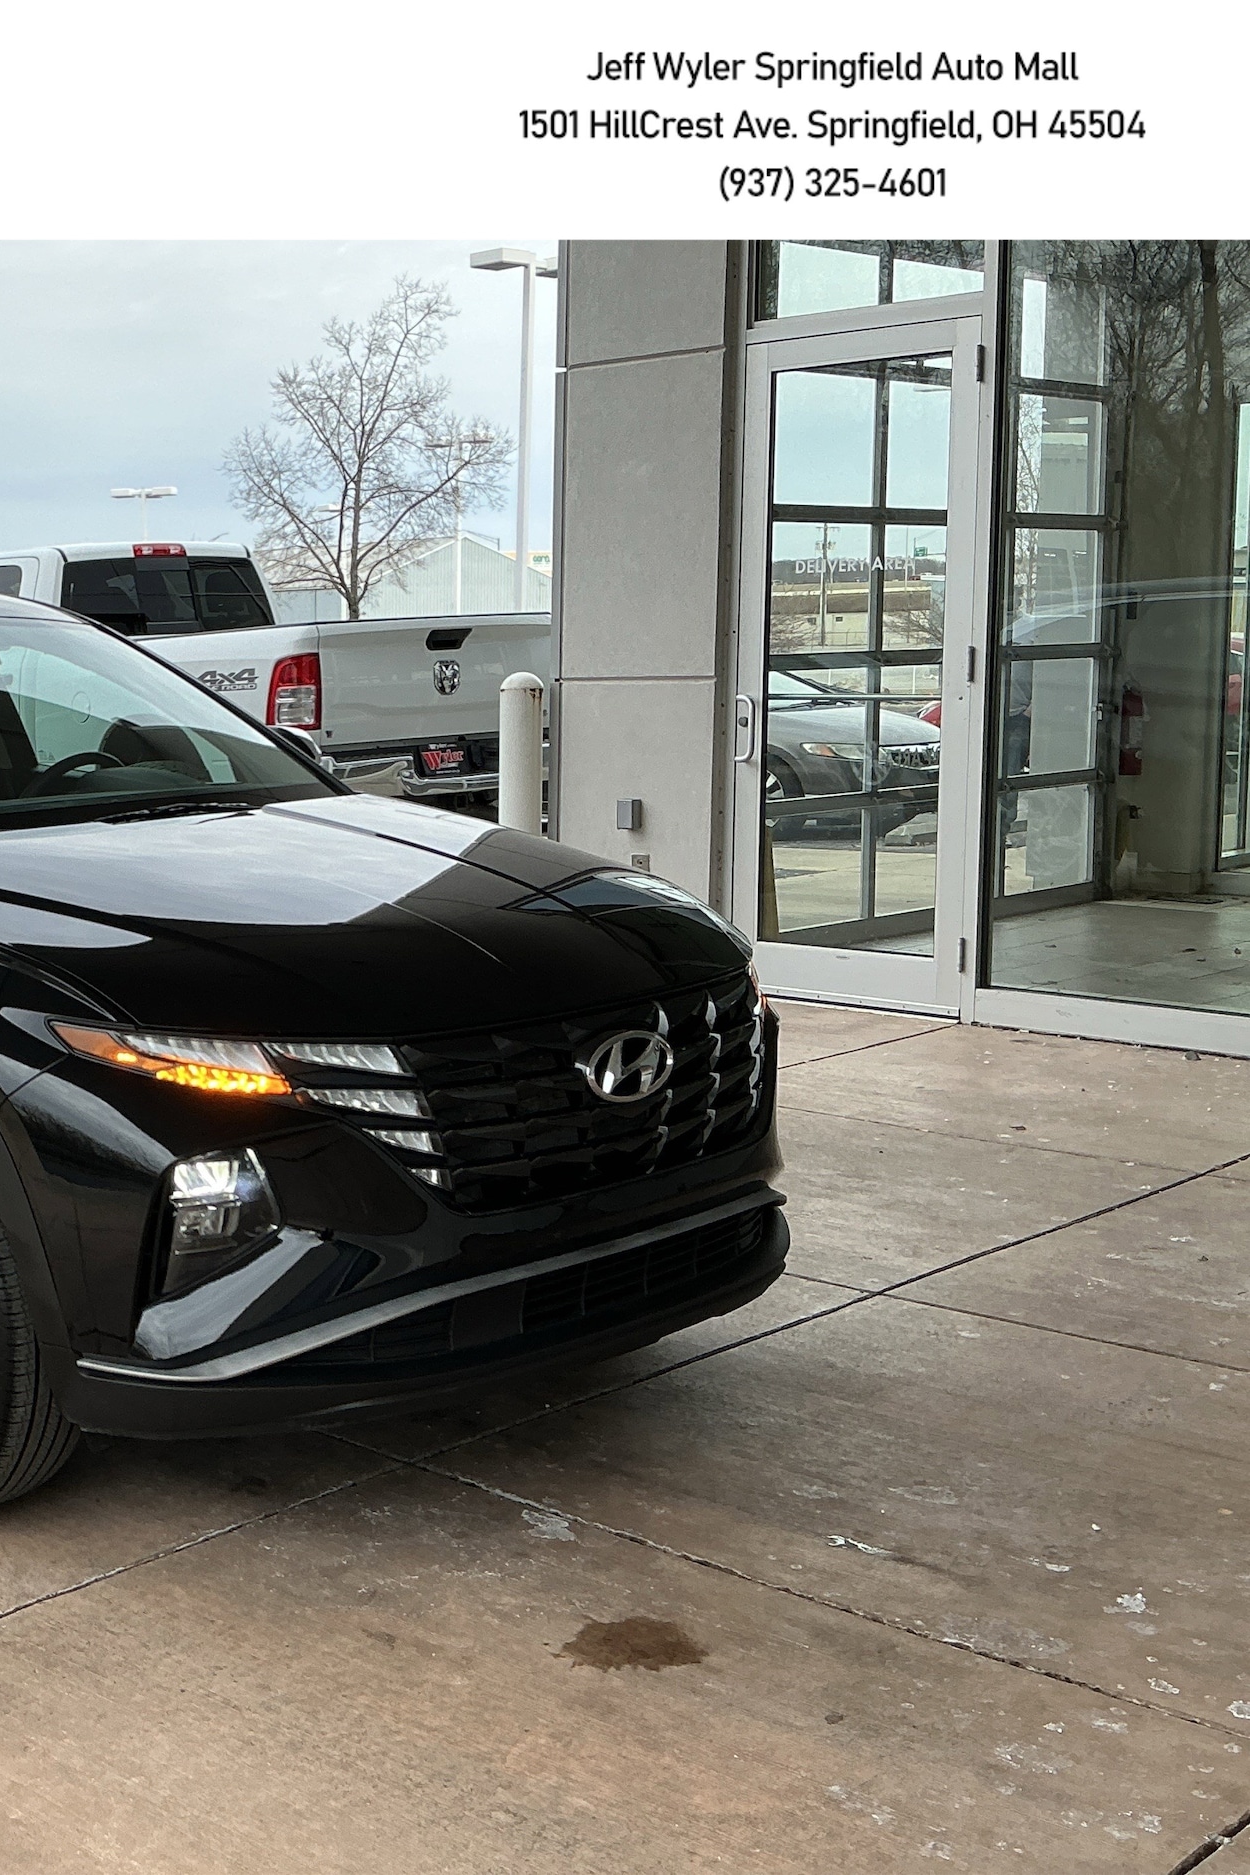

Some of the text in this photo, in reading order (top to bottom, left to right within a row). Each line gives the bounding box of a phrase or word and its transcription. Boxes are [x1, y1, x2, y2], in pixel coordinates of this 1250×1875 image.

[795, 555, 916, 574] DELIVERY AREA
[420, 748, 465, 771] Wyler
